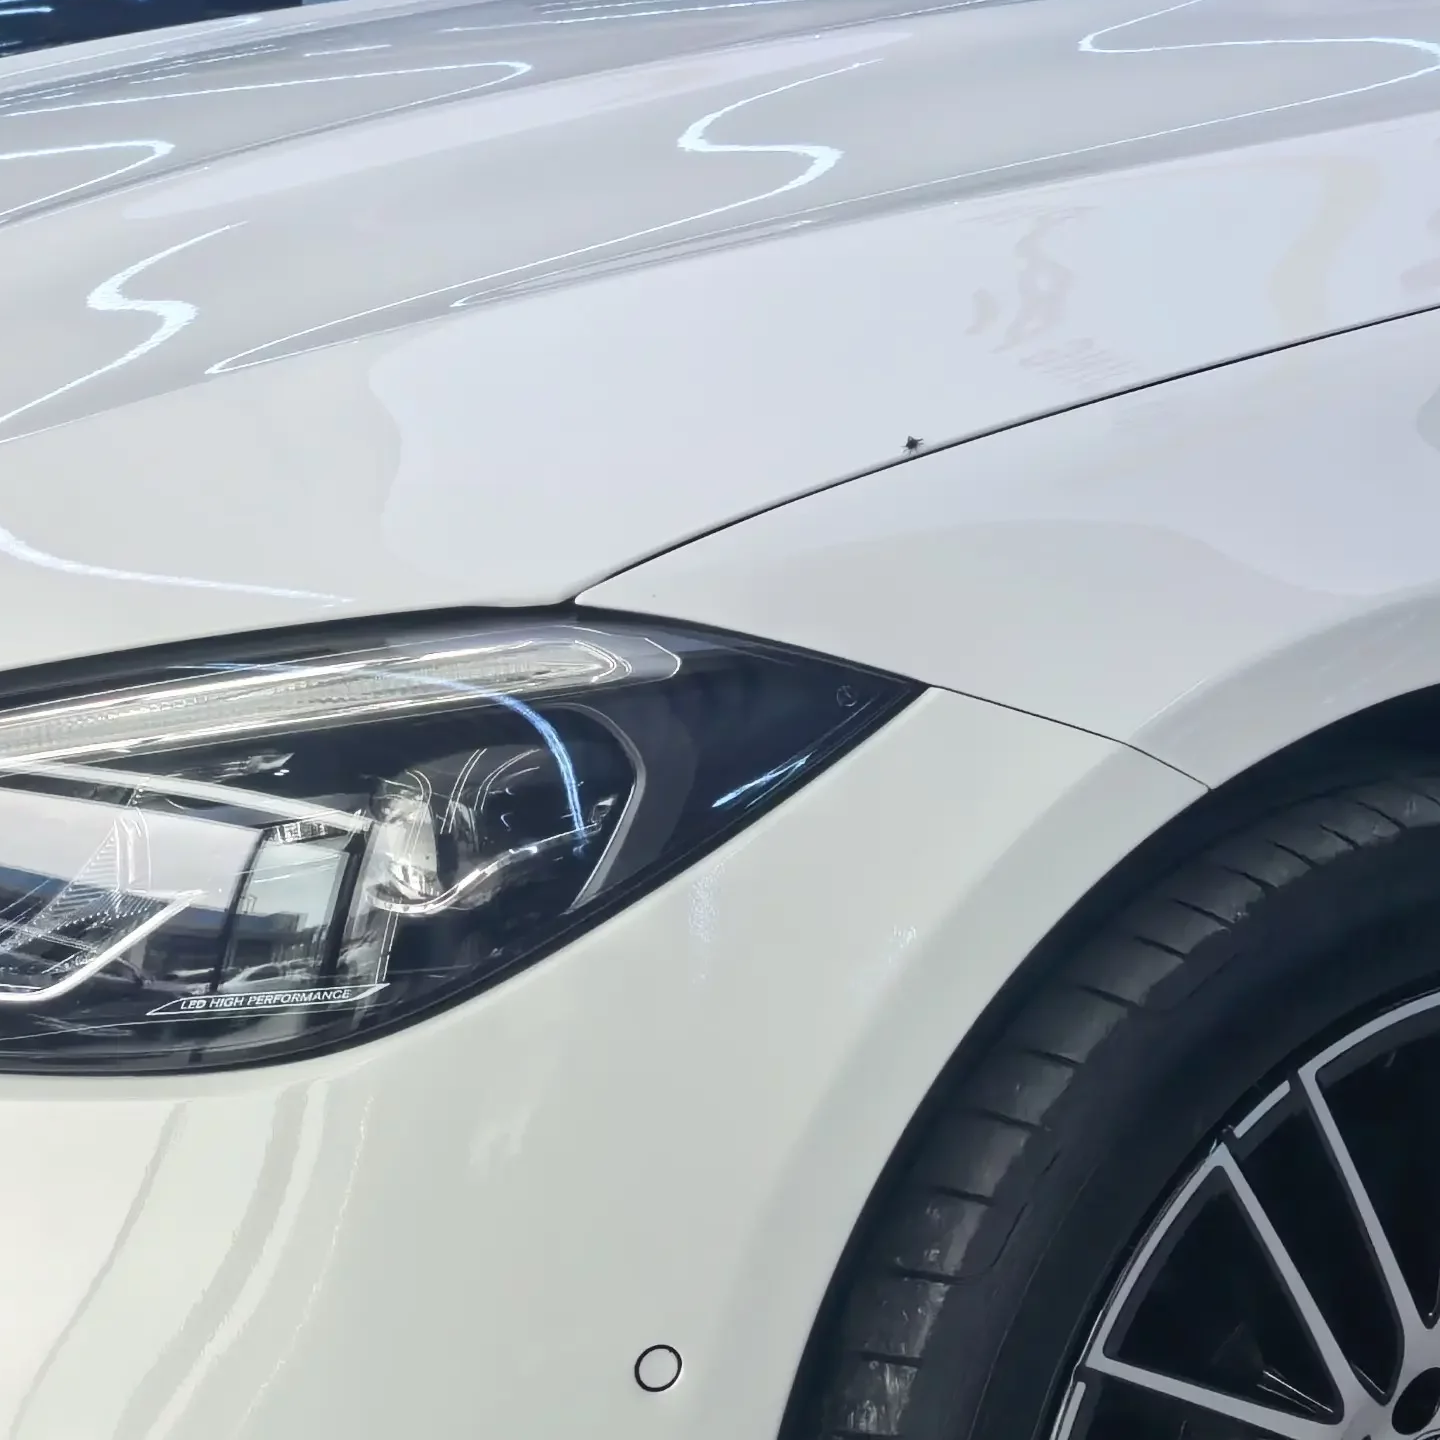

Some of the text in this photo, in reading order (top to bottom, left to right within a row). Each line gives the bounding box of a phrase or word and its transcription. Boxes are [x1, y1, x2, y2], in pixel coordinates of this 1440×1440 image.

[180, 988, 353, 1010] LED HIGH PERFORMANCE
